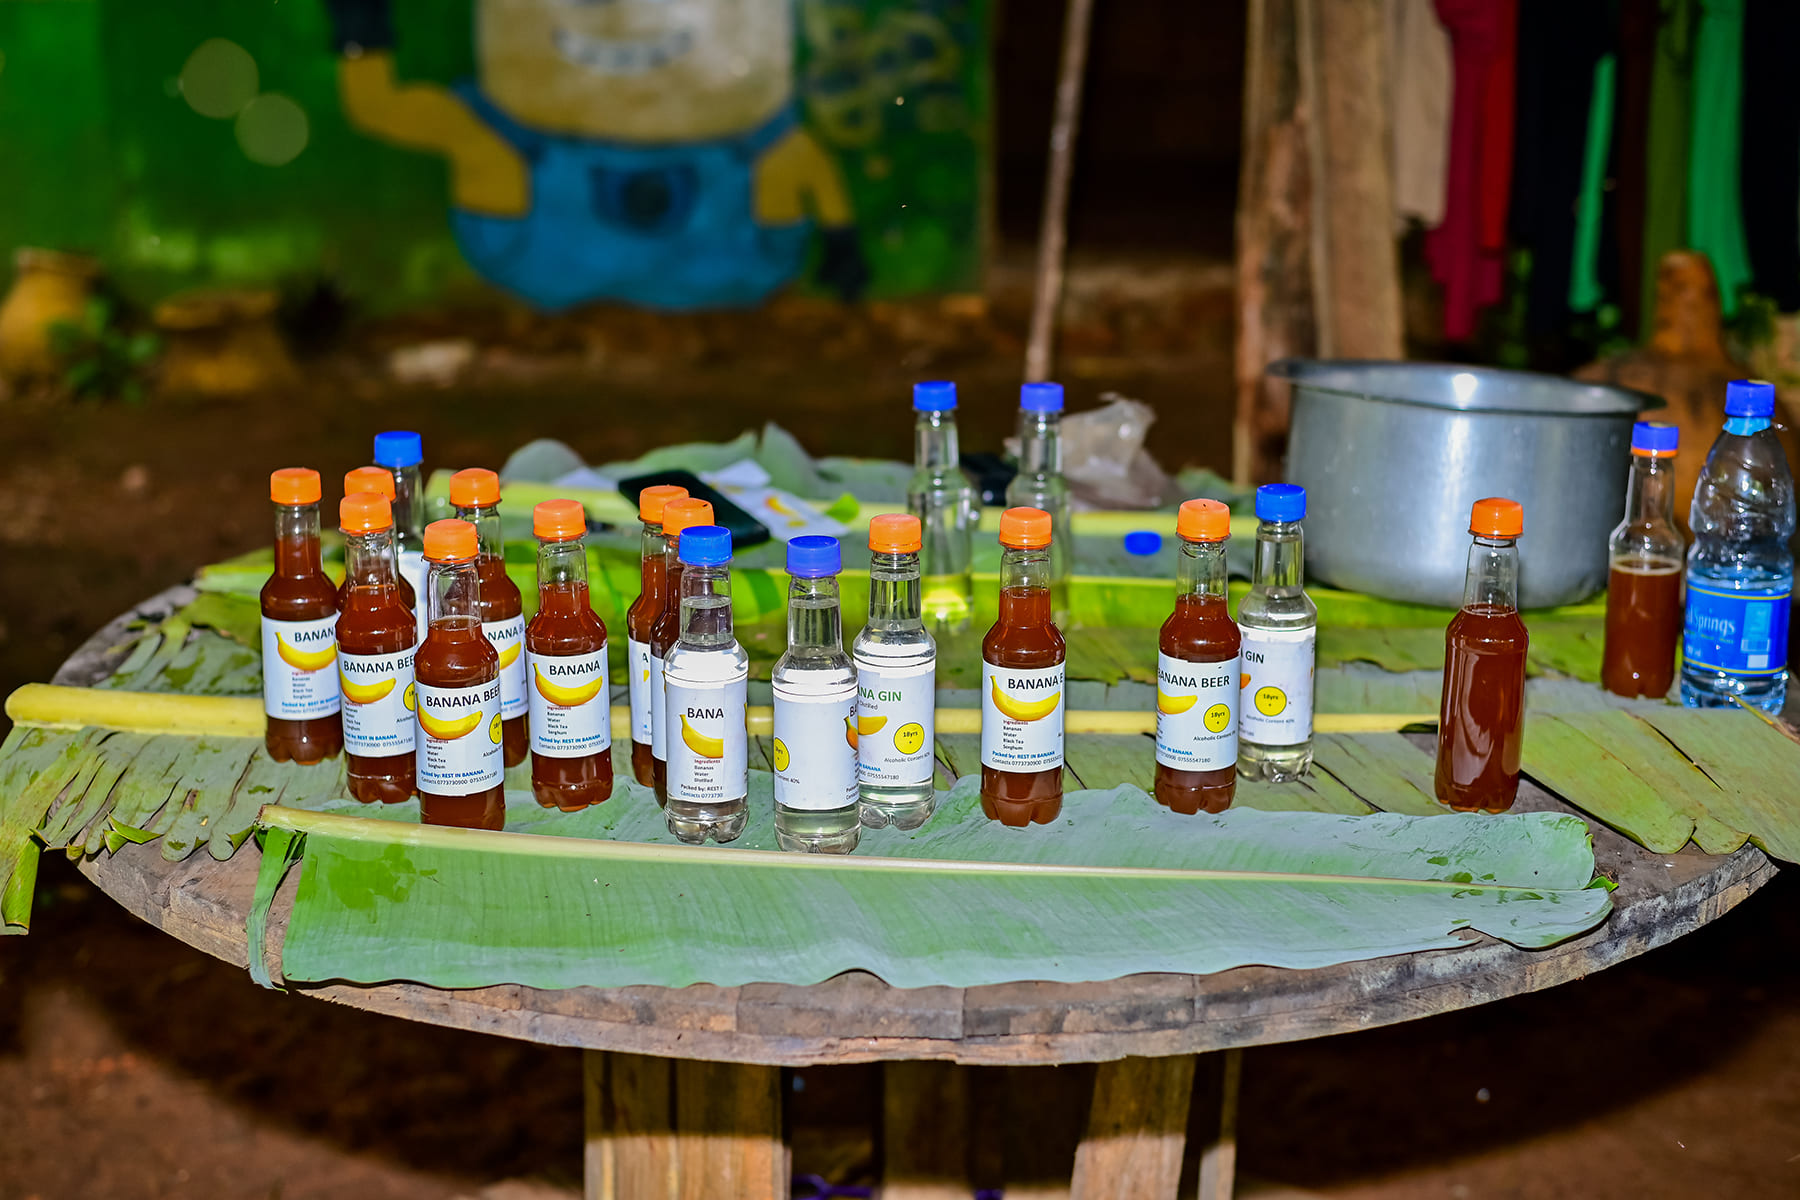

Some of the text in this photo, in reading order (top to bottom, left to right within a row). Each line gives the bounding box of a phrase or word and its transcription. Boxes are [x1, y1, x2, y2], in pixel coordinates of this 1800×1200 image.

[1694, 606, 1736, 637] Springs
[1245, 650, 1265, 664] GIN
[344, 660, 394, 674] BANANA
[549, 660, 601, 676] BANANA
[1008, 675, 1058, 690] BANANA
[1201, 675, 1230, 688] BEER
[426, 694, 482, 708] BANANA
[878, 690, 902, 702] GIN
[688, 707, 724, 719] BANA
[462, 769, 484, 778] BANANA
